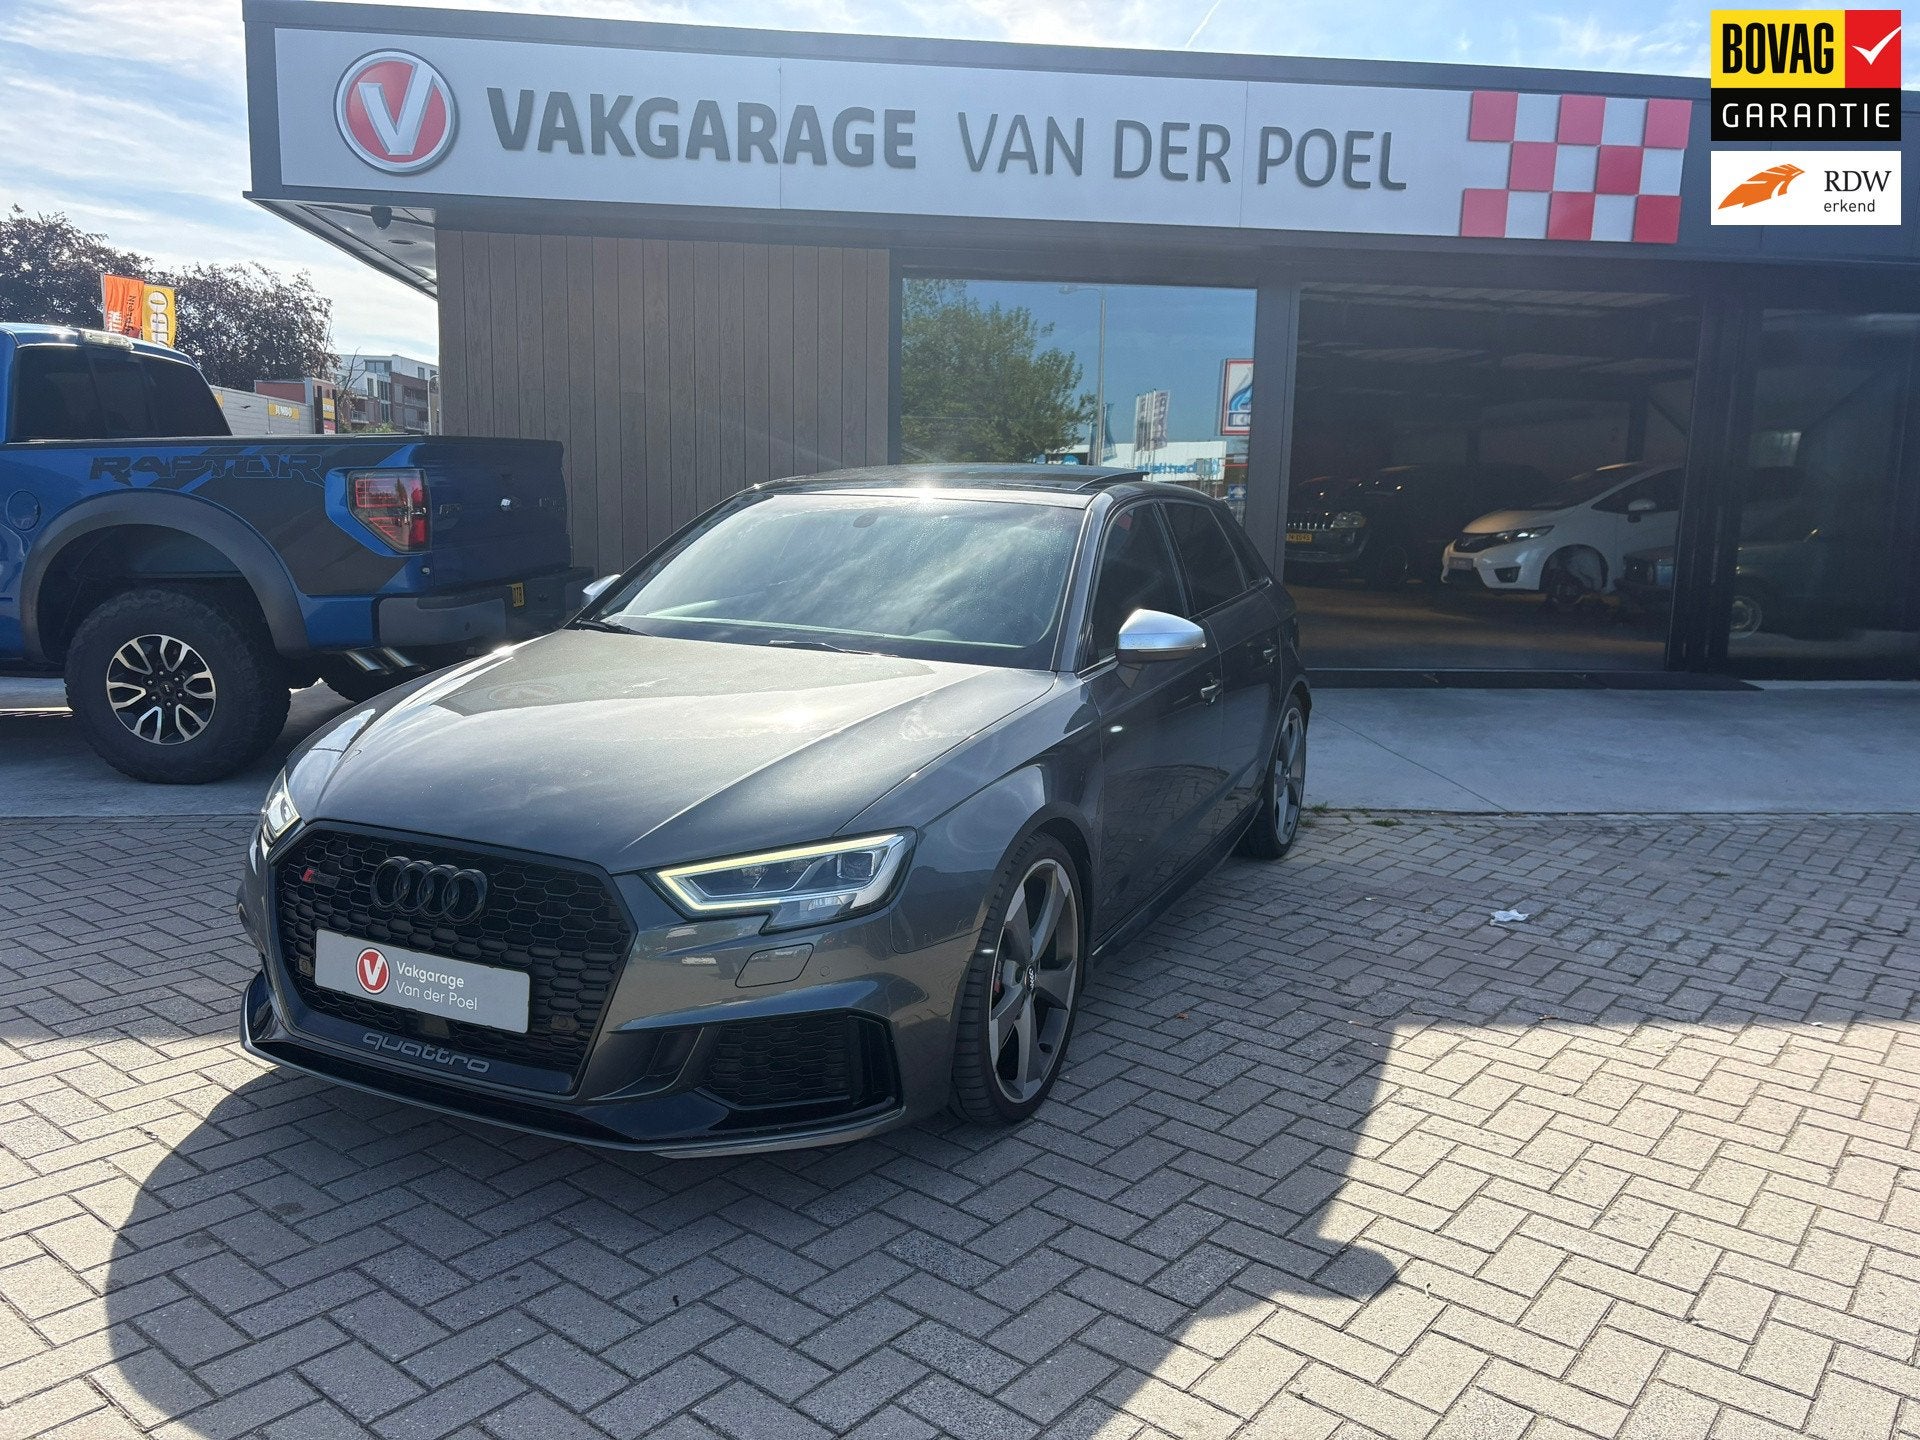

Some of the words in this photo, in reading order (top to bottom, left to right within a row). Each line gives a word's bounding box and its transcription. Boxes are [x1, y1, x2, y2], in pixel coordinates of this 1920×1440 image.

[486, 86, 917, 170] VAKGARAGE
[957, 111, 1085, 177] VAN
[1113, 119, 1232, 184] DER
[1257, 125, 1408, 191] POEL
[88, 453, 325, 489] RAPTOR
[396, 960, 465, 989] Vakgarage
[395, 979, 420, 999] Van
[424, 987, 445, 1004] der
[448, 992, 478, 1011] Poel
[362, 1032, 491, 1074] quattro
